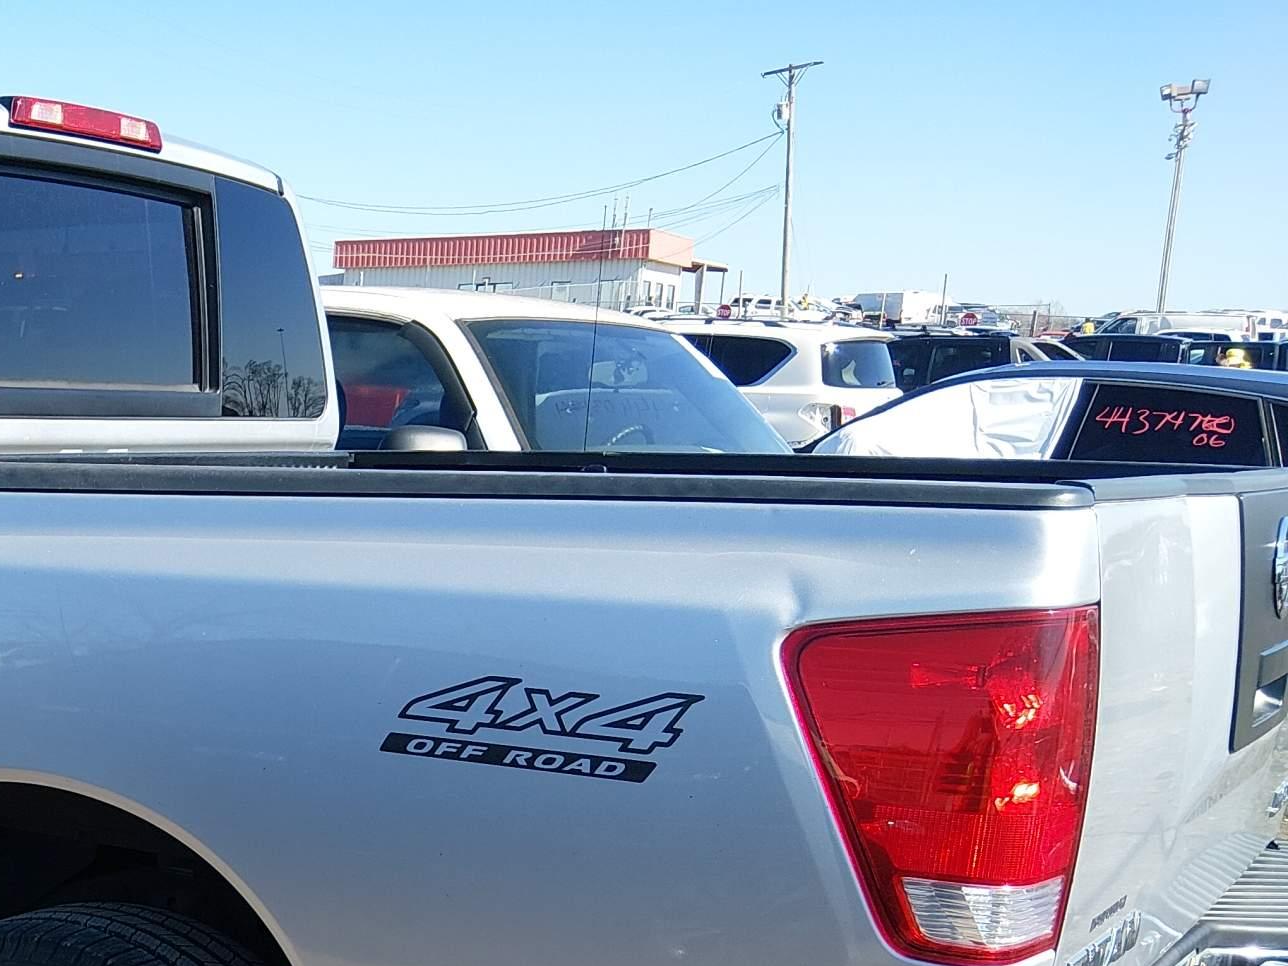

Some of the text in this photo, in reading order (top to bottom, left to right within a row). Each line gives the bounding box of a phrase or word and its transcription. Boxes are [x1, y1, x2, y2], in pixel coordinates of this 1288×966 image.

[961, 317, 977, 325] STOP
[1193, 433, 1226, 448] 06
[405, 738, 627, 777] OFF ROAD
